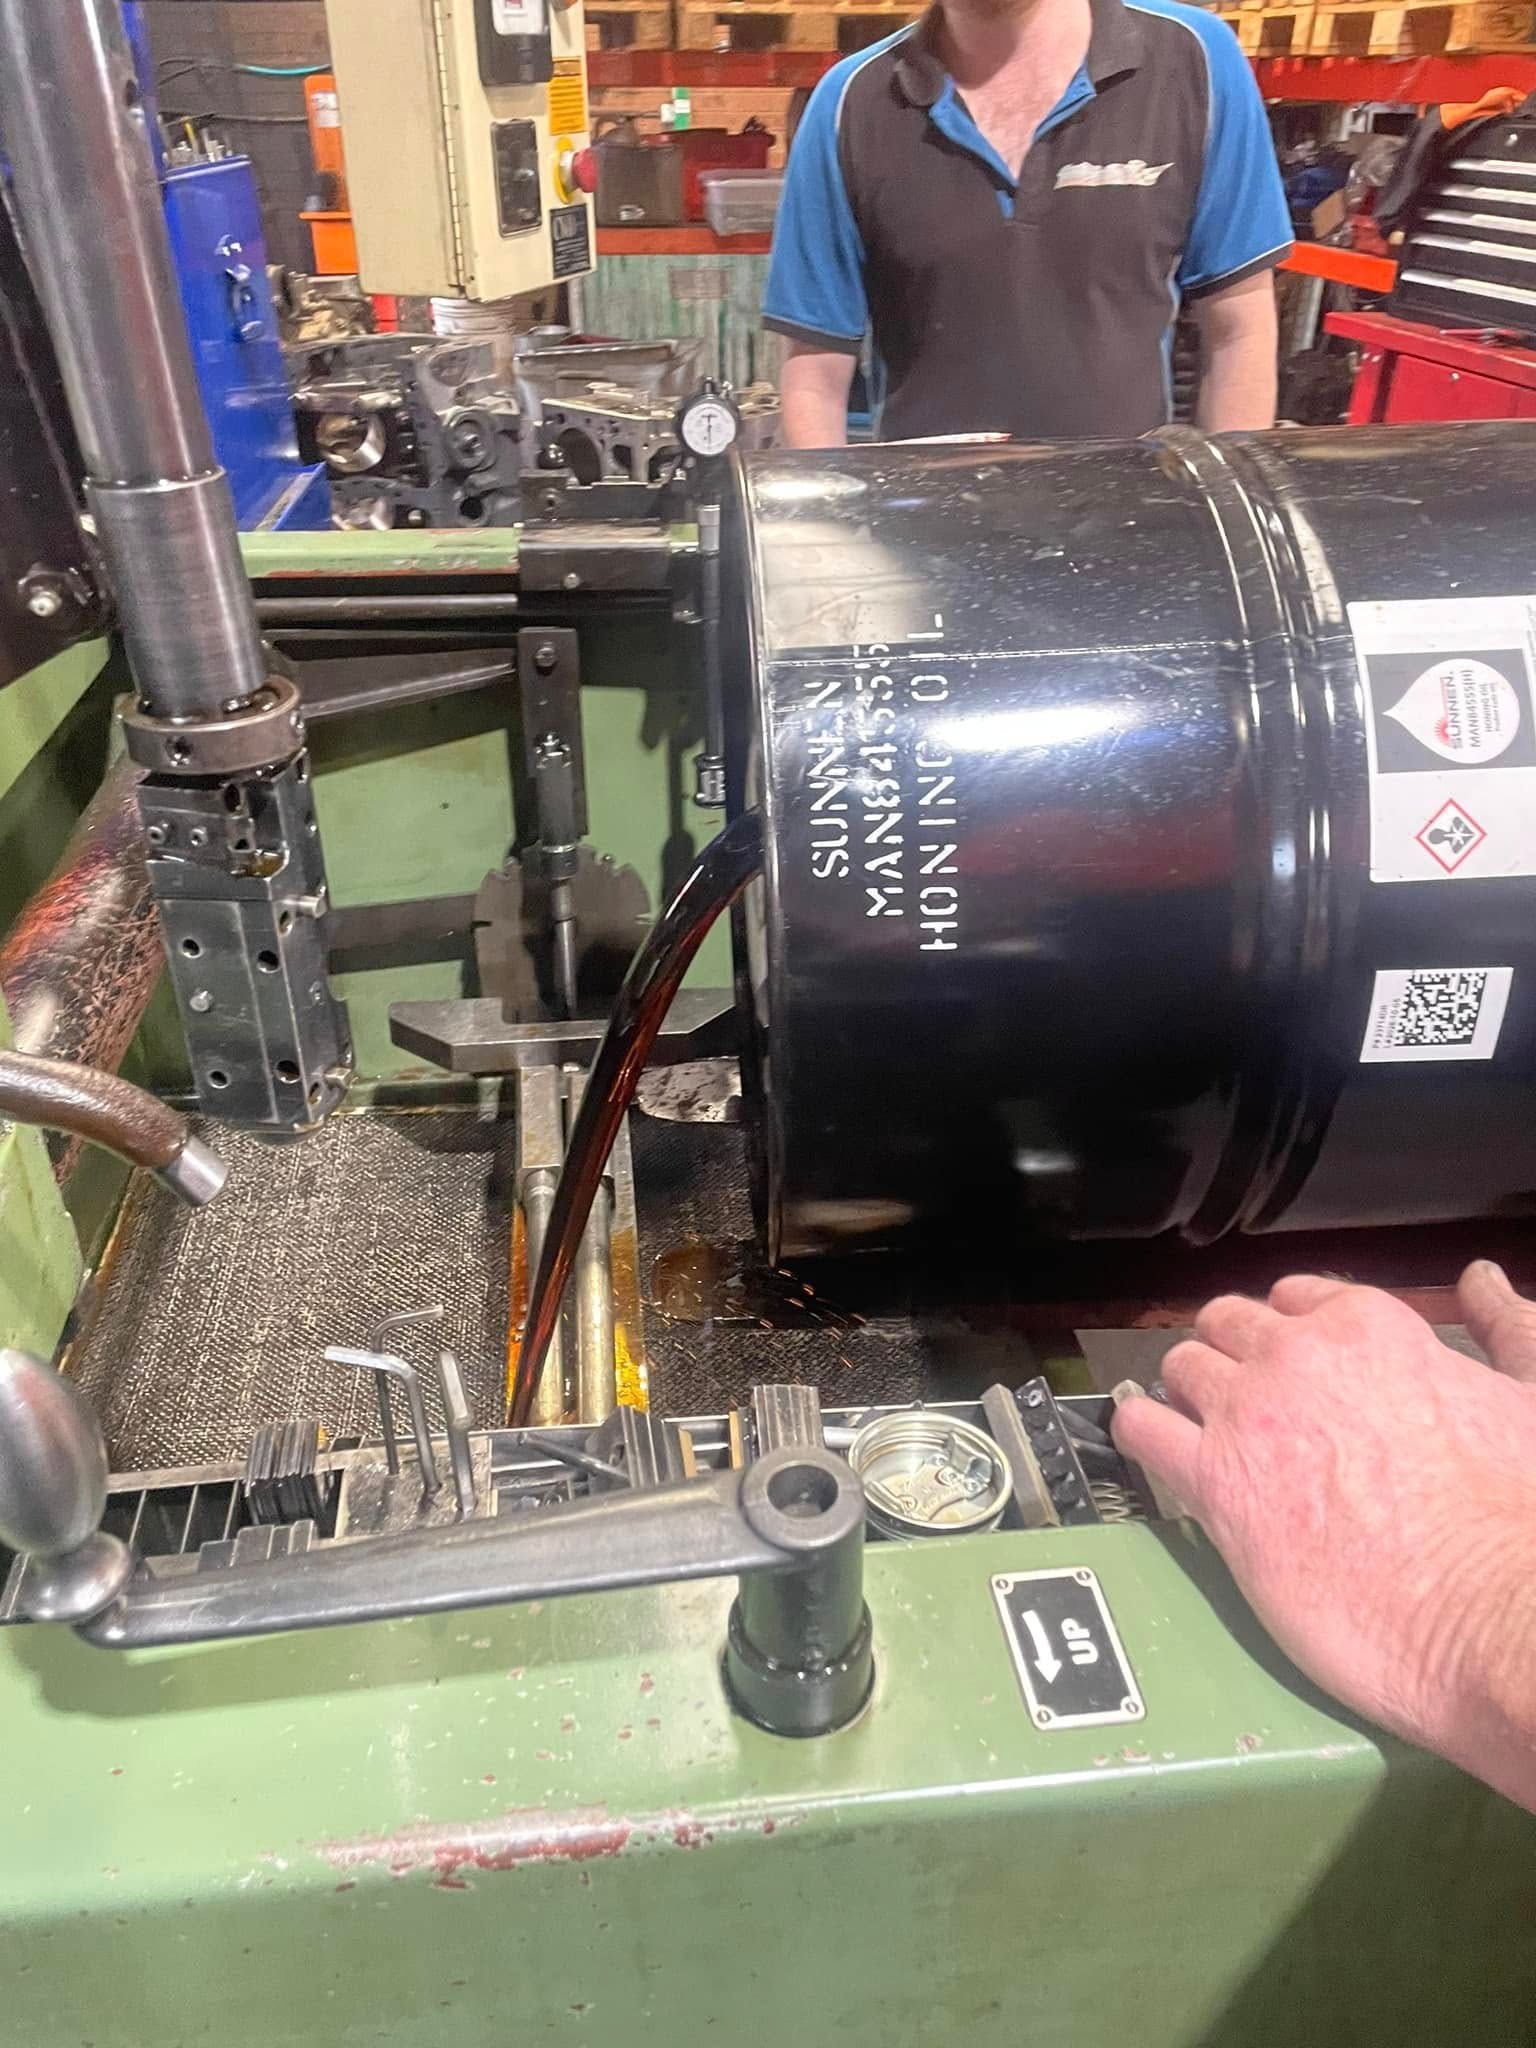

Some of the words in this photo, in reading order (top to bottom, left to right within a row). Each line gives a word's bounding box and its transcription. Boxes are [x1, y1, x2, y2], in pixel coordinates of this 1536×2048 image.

[906, 613, 949, 701] OIL
[804, 681, 849, 878] SUNNEN
[853, 643, 904, 917] MAN84555
[914, 739, 959, 951] HONING
[1061, 1617, 1099, 1665] UP
